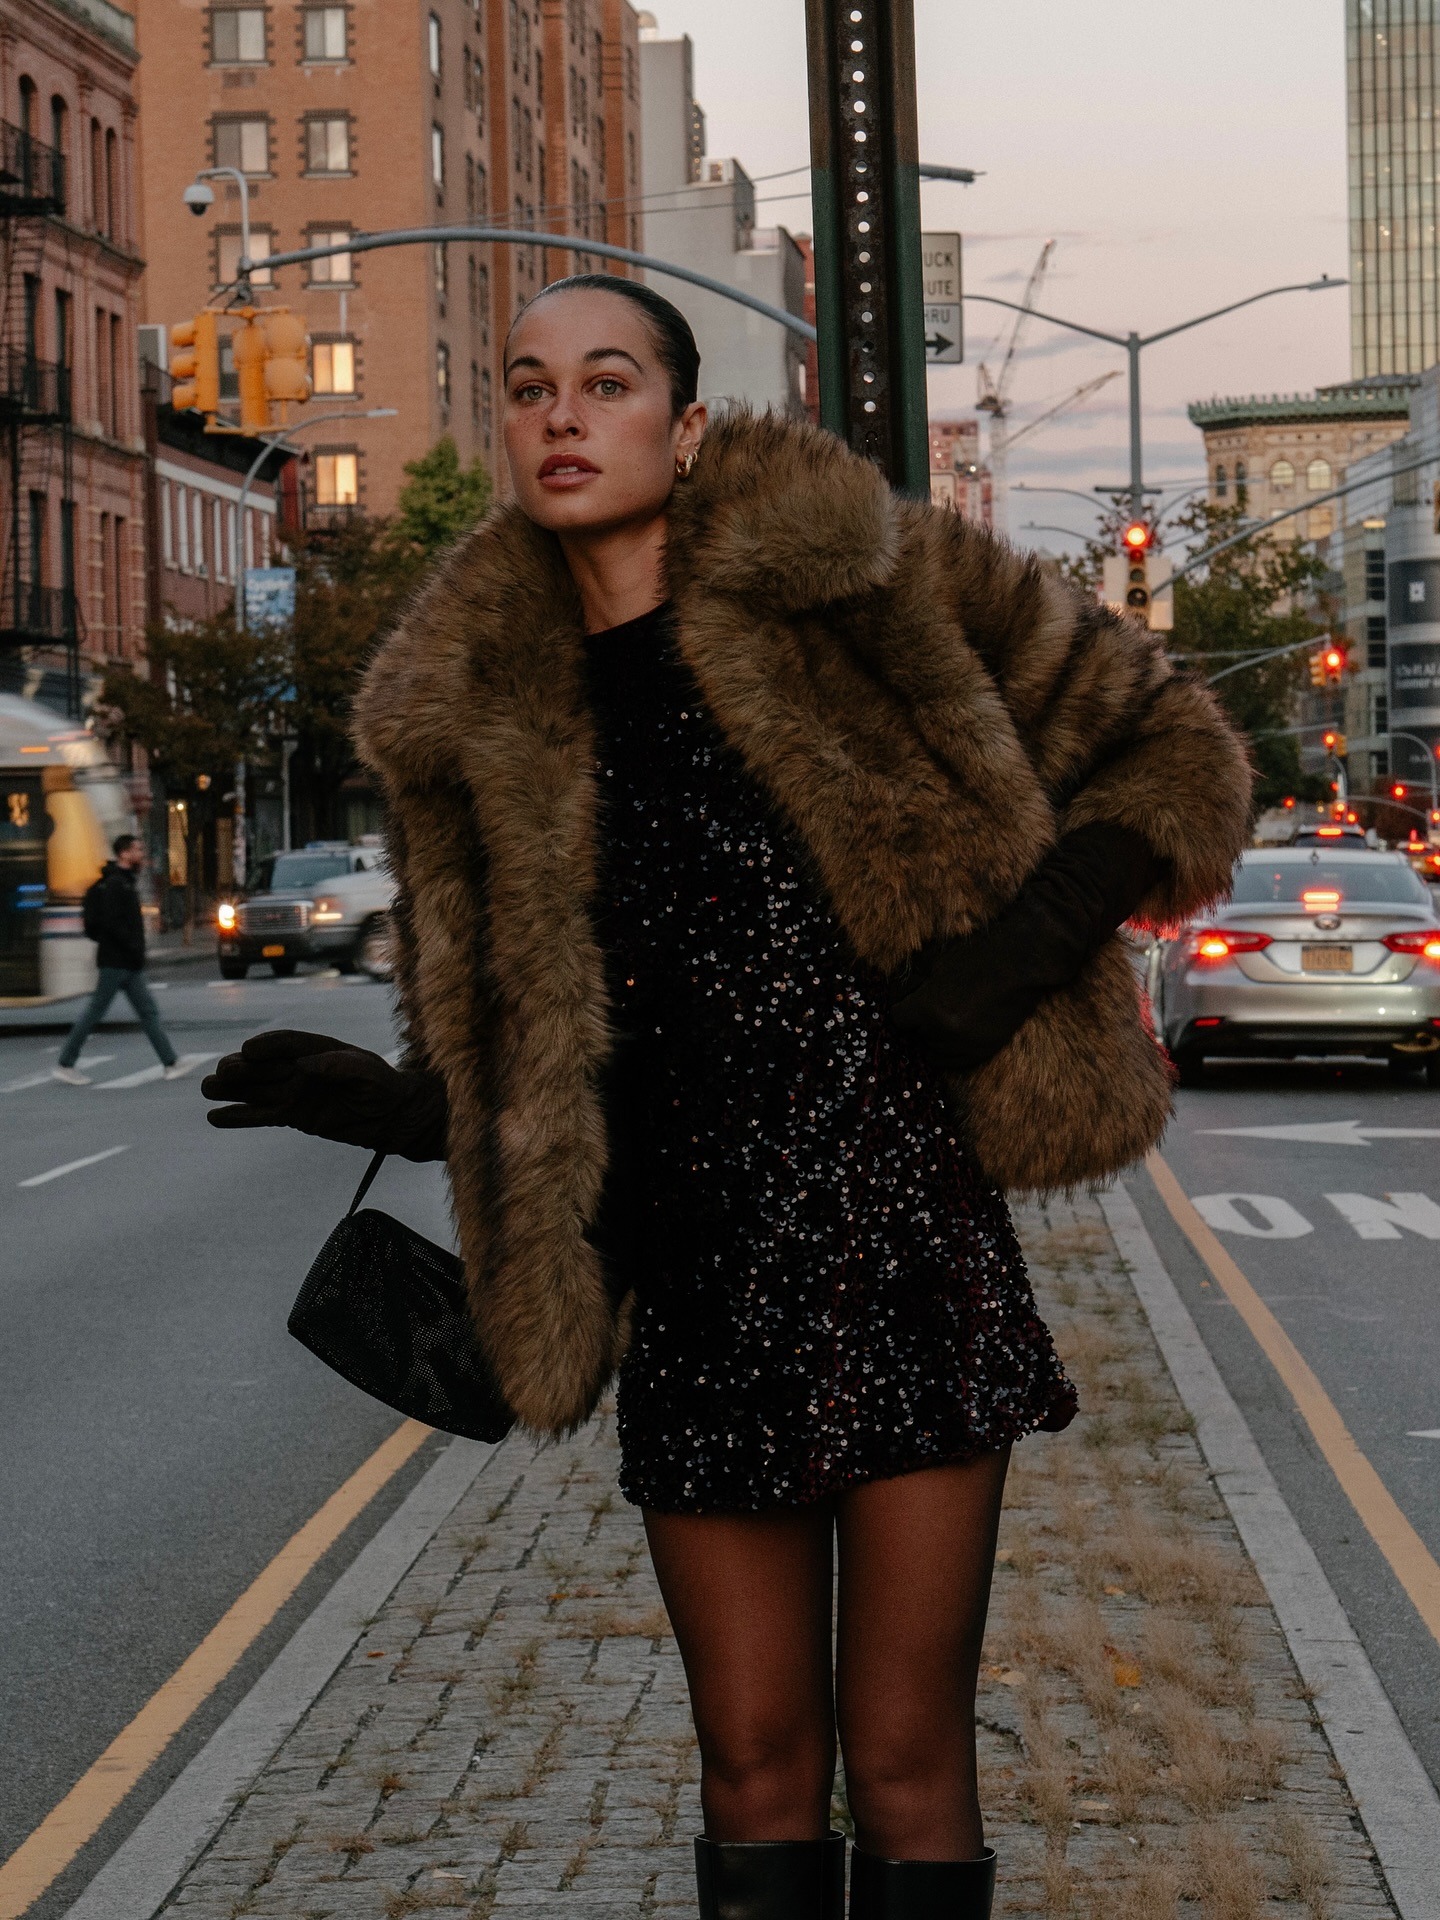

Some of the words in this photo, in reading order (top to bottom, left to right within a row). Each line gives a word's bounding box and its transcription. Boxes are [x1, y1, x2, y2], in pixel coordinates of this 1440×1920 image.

[924, 251, 954, 267] UCK
[926, 280, 953, 296] UTE
[924, 308, 951, 323] HRU
